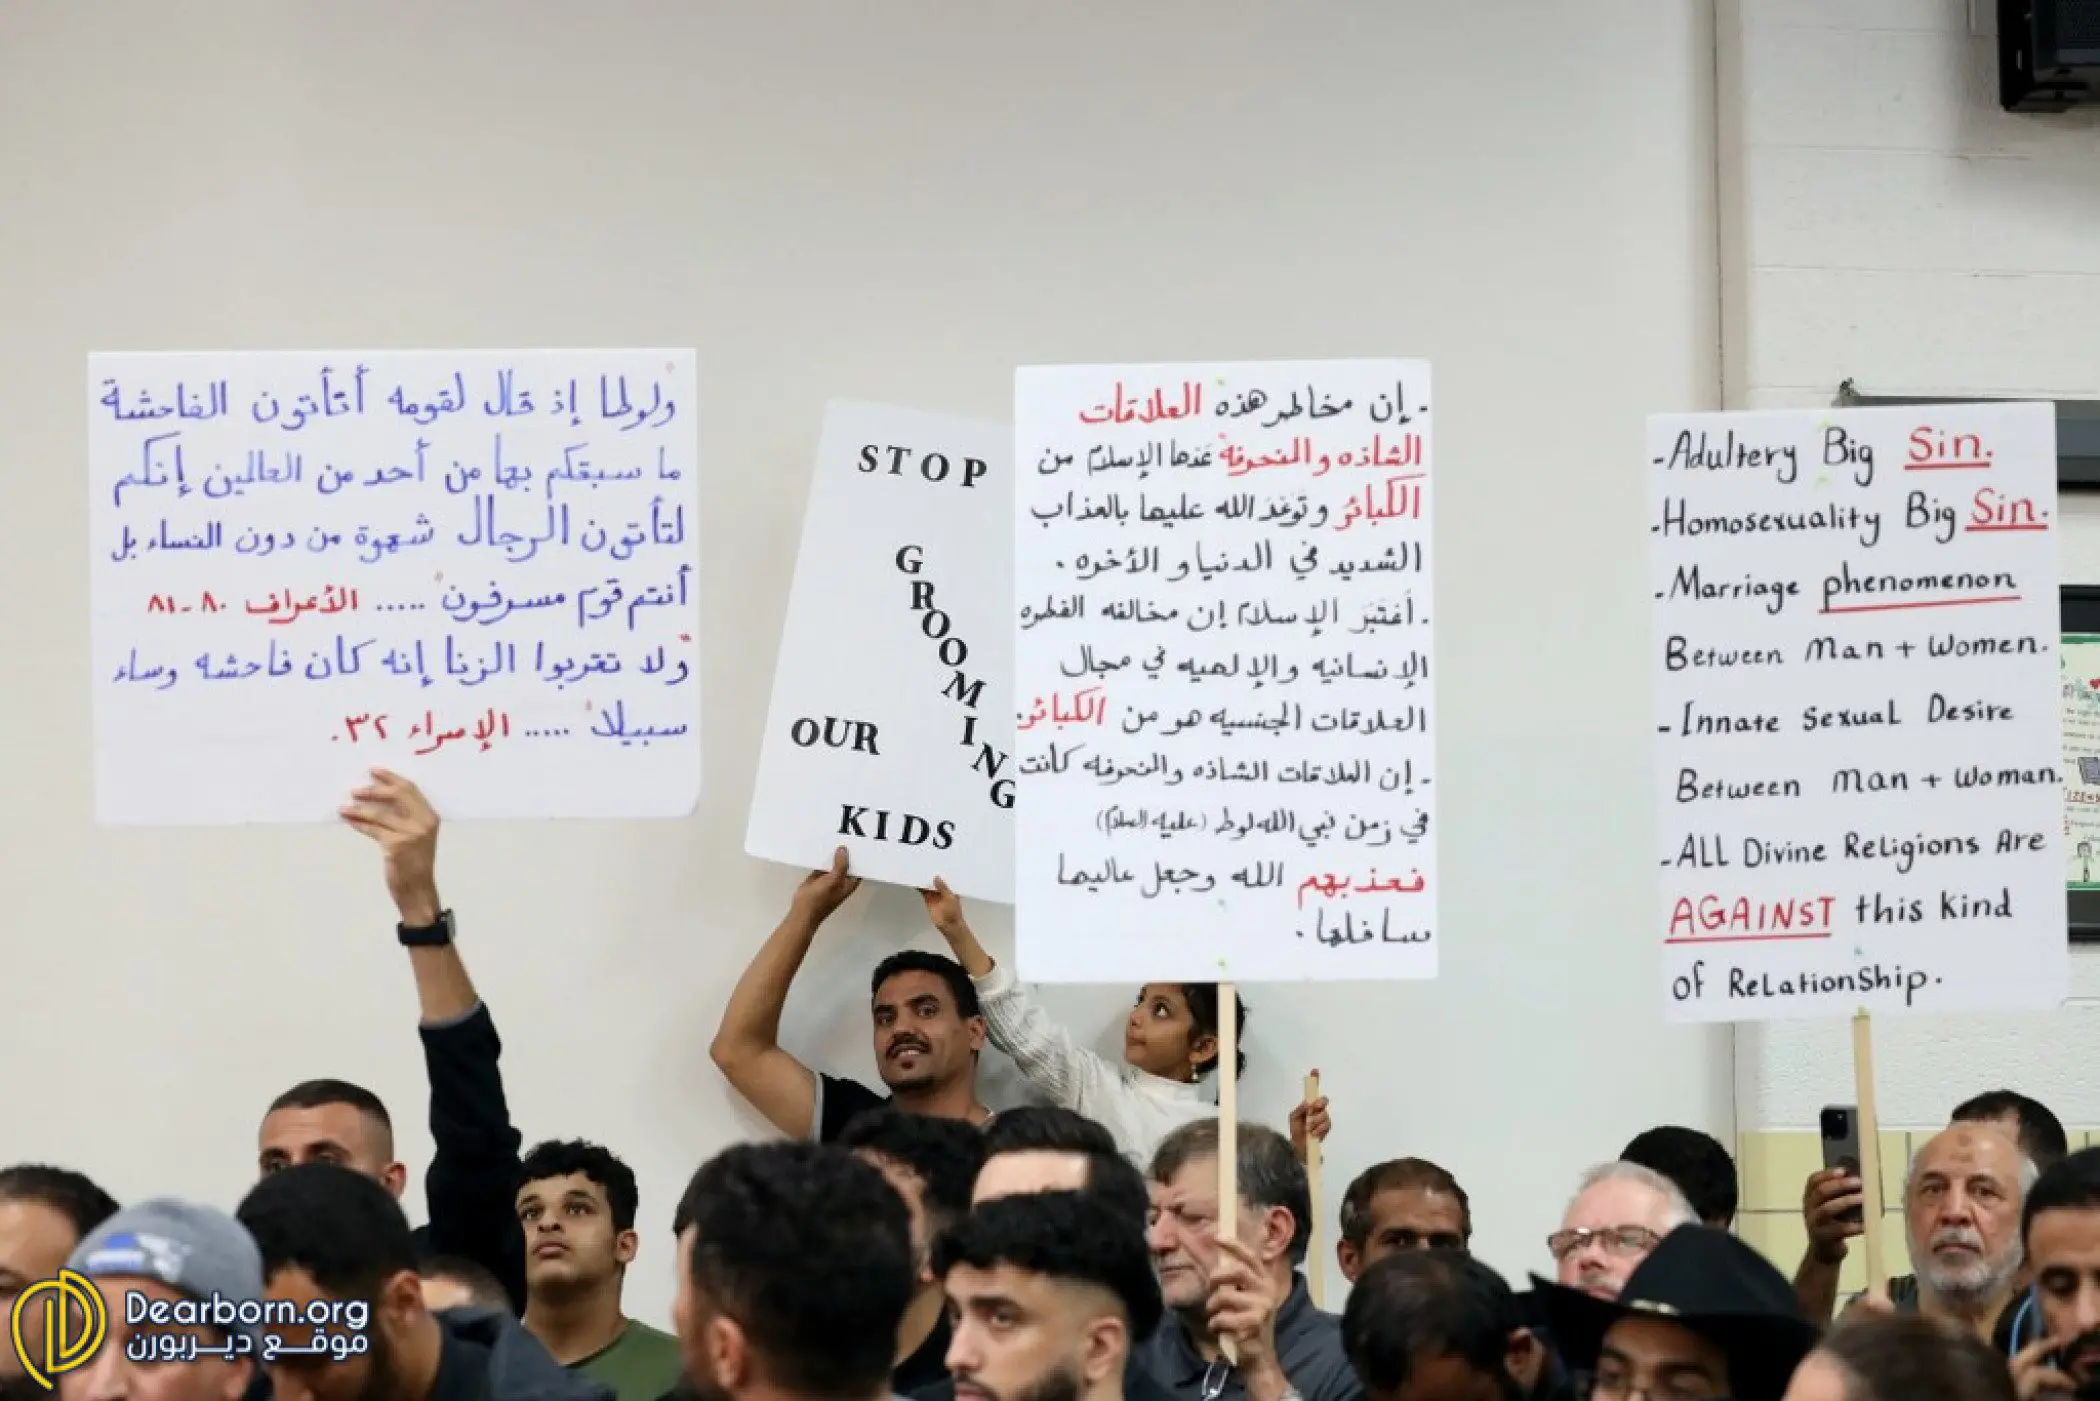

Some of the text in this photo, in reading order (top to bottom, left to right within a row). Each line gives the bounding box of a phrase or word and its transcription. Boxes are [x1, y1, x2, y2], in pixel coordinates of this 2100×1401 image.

[100, 379, 226, 420] الفاحشة
[252, 364, 369, 431] أتأتون
[484, 369, 535, 416] قال
[552, 379, 581, 427] إذ
[1079, 382, 1201, 424] العلاقات
[113, 431, 192, 508] إنكم
[363, 437, 430, 486] أحد
[496, 433, 533, 492] بها
[546, 443, 642, 500] سبقكم
[660, 447, 681, 480] ما
[857, 445, 987, 488] STOP
[1038, 448, 1073, 476] من
[1823, 425, 1874, 488] Big
[1908, 425, 1994, 461] Sin.
[318, 464, 353, 494] من
[445, 461, 482, 494] من
[1031, 490, 1130, 529] بالعذاب
[1140, 492, 1204, 529] عليها
[1214, 492, 1255, 520] الله
[1333, 474, 1426, 531] الكبائر
[1905, 490, 1956, 544] Big
[1970, 487, 2050, 524] Sin.
[111, 493, 683, 564] لتأتون الرجال شهوة من دون النساء بل
[1196, 539, 1272, 581] الدنيا
[1290, 541, 1318, 581] في
[1329, 541, 1421, 581] الشديد
[246, 584, 359, 624] الأعراف
[578, 578, 624, 628] قوم
[627, 564, 692, 631] أنتم
[1823, 560, 2017, 612] phenomenon
[1238, 597, 1337, 637] الإسلام
[113, 648, 177, 690] وساء
[305, 634, 376, 680] كان
[381, 640, 435, 688] إنه
[447, 634, 515, 686] الزنا
[535, 642, 622, 690] تقربوا
[1060, 644, 1132, 679] مجال
[1142, 646, 1165, 679] في
[1665, 636, 1784, 672] Between
[1805, 636, 1883, 661] Man
[1928, 634, 2048, 657] Women.
[895, 543, 1015, 810] GROOMING
[1122, 706, 1159, 734] من
[1158, 709, 1202, 736] هو
[1310, 705, 1426, 735] العلاقات
[1928, 692, 2014, 723] Desire
[791, 716, 880, 755] OUR
[1019, 741, 1086, 775] كانت
[1277, 759, 1370, 786] العلاقات
[1676, 767, 1801, 804] Between
[1833, 769, 1909, 794] Man
[1954, 765, 2063, 788] Woman.
[837, 804, 956, 850] KIDS
[1214, 806, 1254, 841] لوط
[1255, 806, 1296, 834] الله
[1298, 810, 1335, 848] نبي
[1344, 814, 1391, 847] زمن
[1400, 808, 1429, 845] في
[1743, 837, 1827, 868] Divine
[1995, 828, 2045, 854] Are
[1141, 862, 1216, 898] وجعل
[1231, 861, 1284, 888] الله
[1298, 868, 1425, 910] فعذبهم
[1669, 894, 1836, 936] AGAINST
[1856, 892, 1923, 925] this
